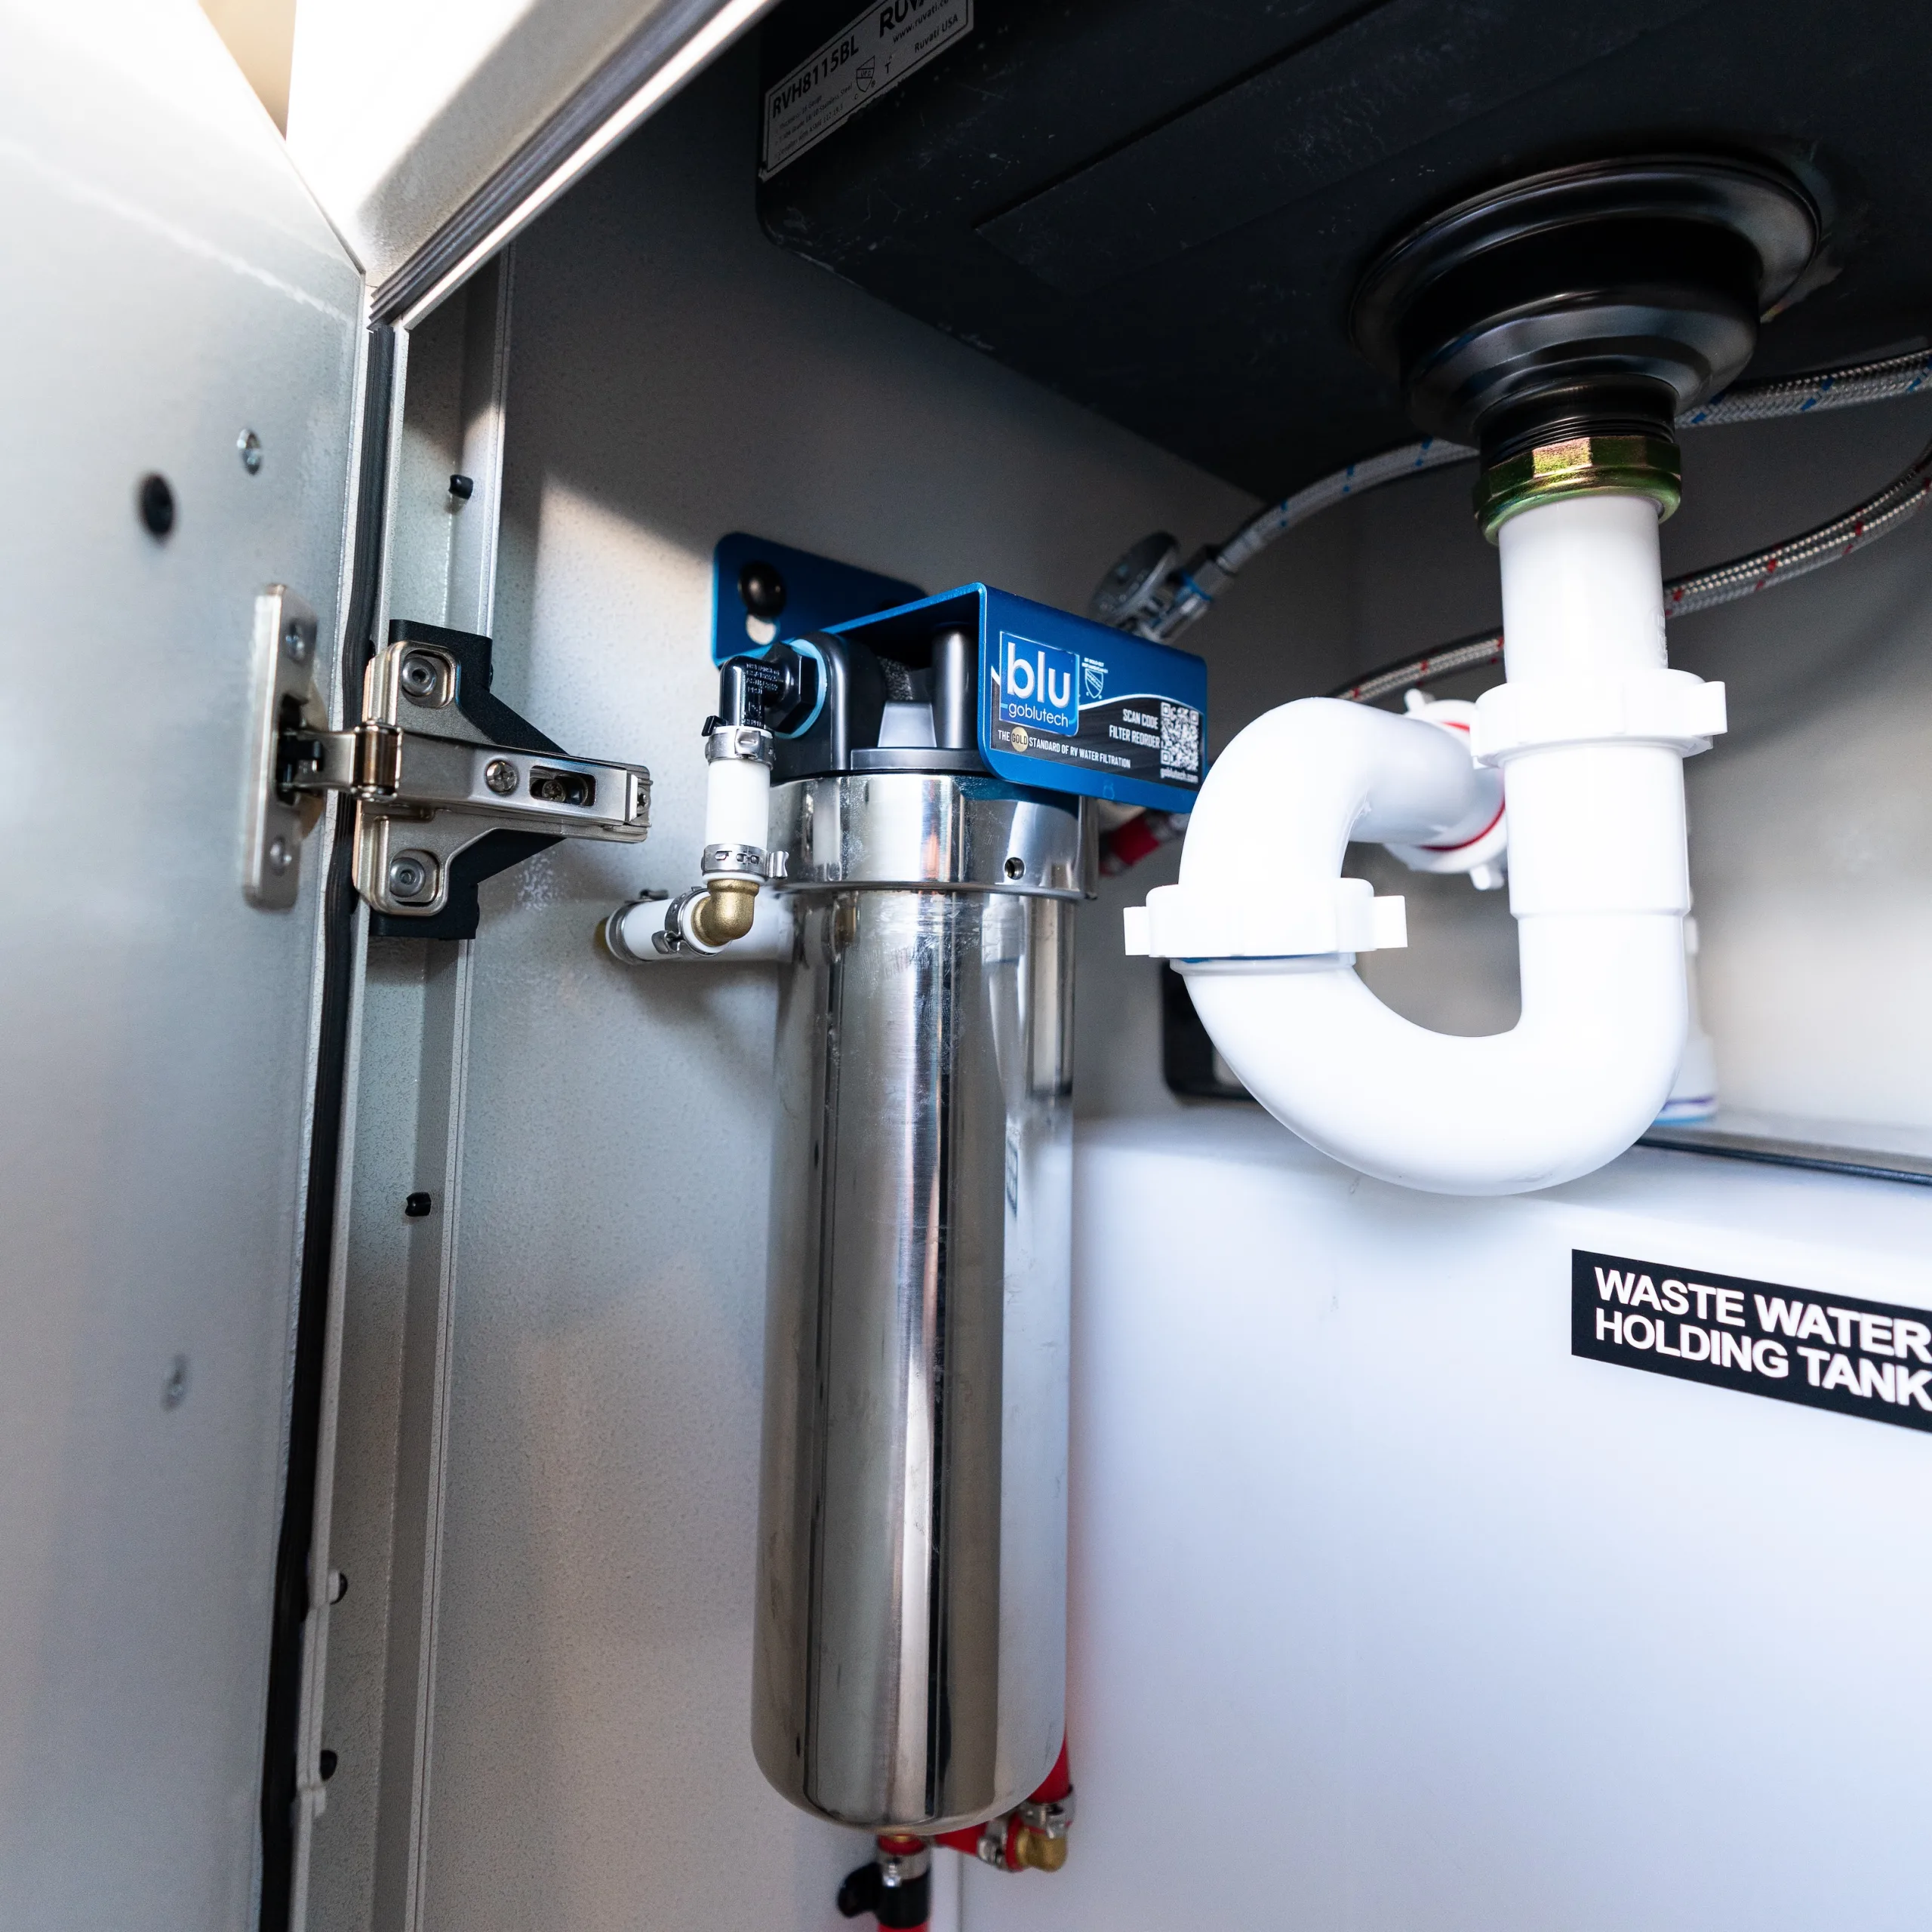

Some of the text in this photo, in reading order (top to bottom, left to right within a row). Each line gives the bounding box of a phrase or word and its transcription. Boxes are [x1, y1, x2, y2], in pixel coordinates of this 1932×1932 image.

[879, 0, 925, 38] RU
[915, 14, 958, 53] Ruvati USA
[772, 35, 860, 118] RVH8115BL
[840, 84, 853, 97] Steel
[1007, 641, 1071, 709] blu
[1008, 703, 1069, 728] goblutech
[1123, 709, 1158, 730] SCAN CODE
[998, 730, 1131, 768] THE GOLD STANDARD OF RV WATER FILTRATION
[1109, 724, 1161, 749] FILTER REORDER
[1160, 768, 1198, 784] goblutech.com
[1594, 1266, 1932, 1363] WASTE WATER
[1595, 1308, 1932, 1411] HOLDING TANK
